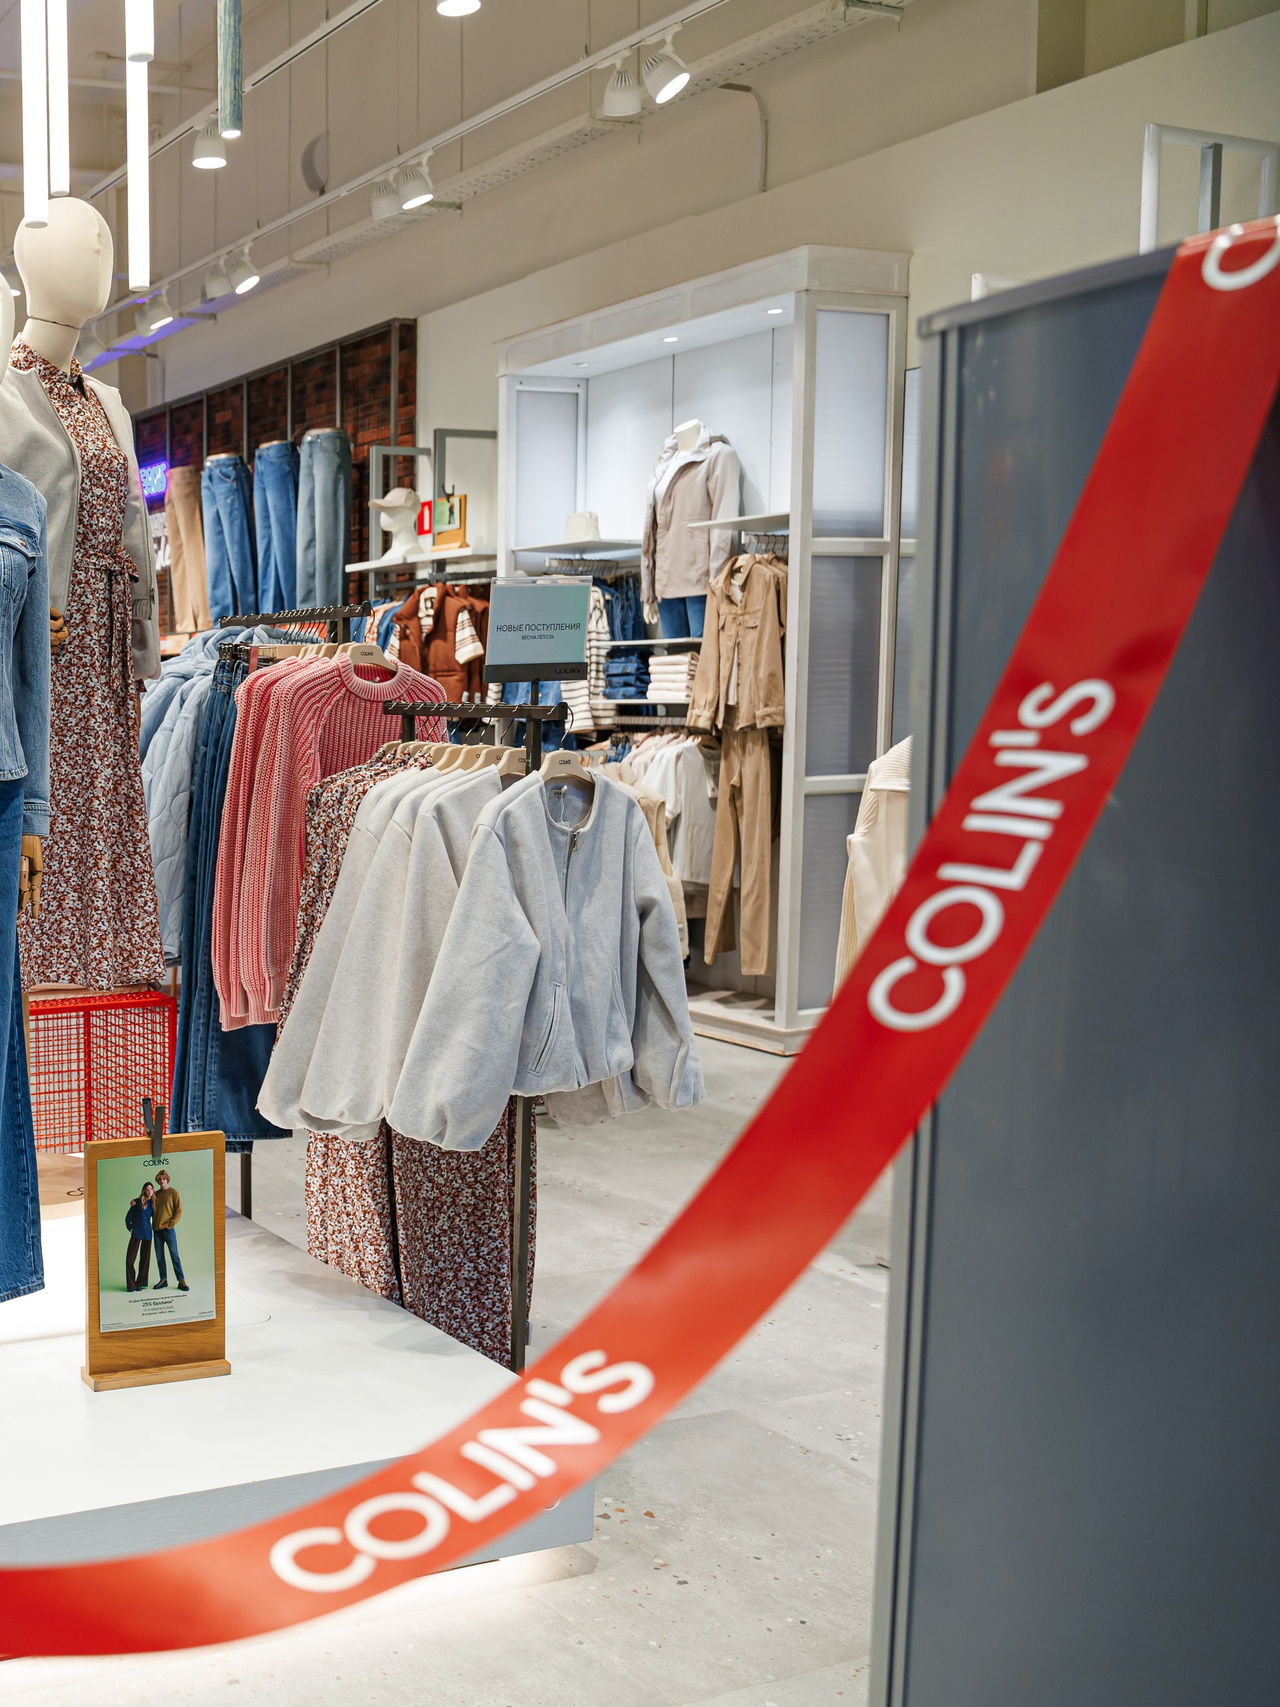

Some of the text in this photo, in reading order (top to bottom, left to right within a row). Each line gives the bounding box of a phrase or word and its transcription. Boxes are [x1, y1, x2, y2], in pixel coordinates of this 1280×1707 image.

[496, 622, 581, 632] НОВЫЕ ПОСТУПЛЕНИЯ
[867, 678, 1117, 1033] COLIN'S
[143, 1158, 170, 1167] COLIN'S
[270, 1350, 655, 1593] COLIN'S
